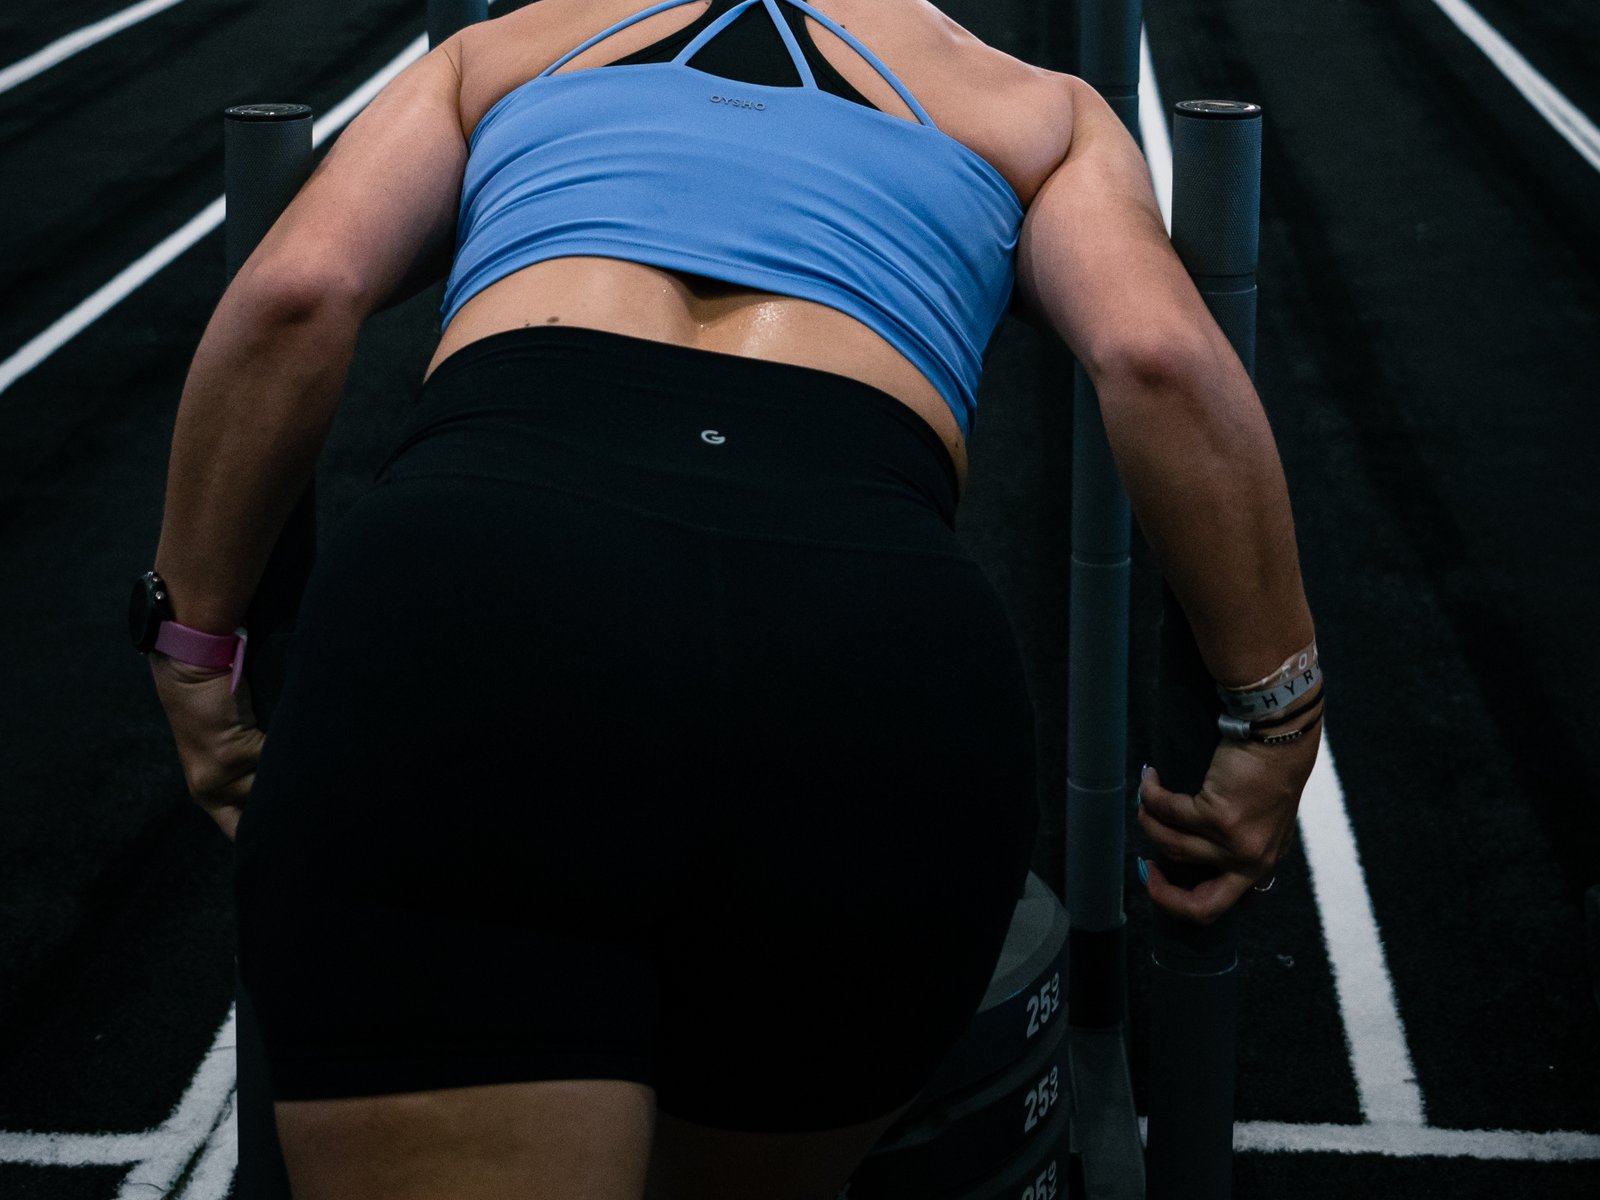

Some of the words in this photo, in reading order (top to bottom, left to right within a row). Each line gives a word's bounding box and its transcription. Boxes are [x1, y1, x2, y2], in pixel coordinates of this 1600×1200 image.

[709, 95, 767, 112] OYSHO
[700, 429, 726, 445] G
[1261, 663, 1319, 709] HYR
[1026, 980, 1051, 1040] 25
[1024, 1073, 1049, 1134] 25
